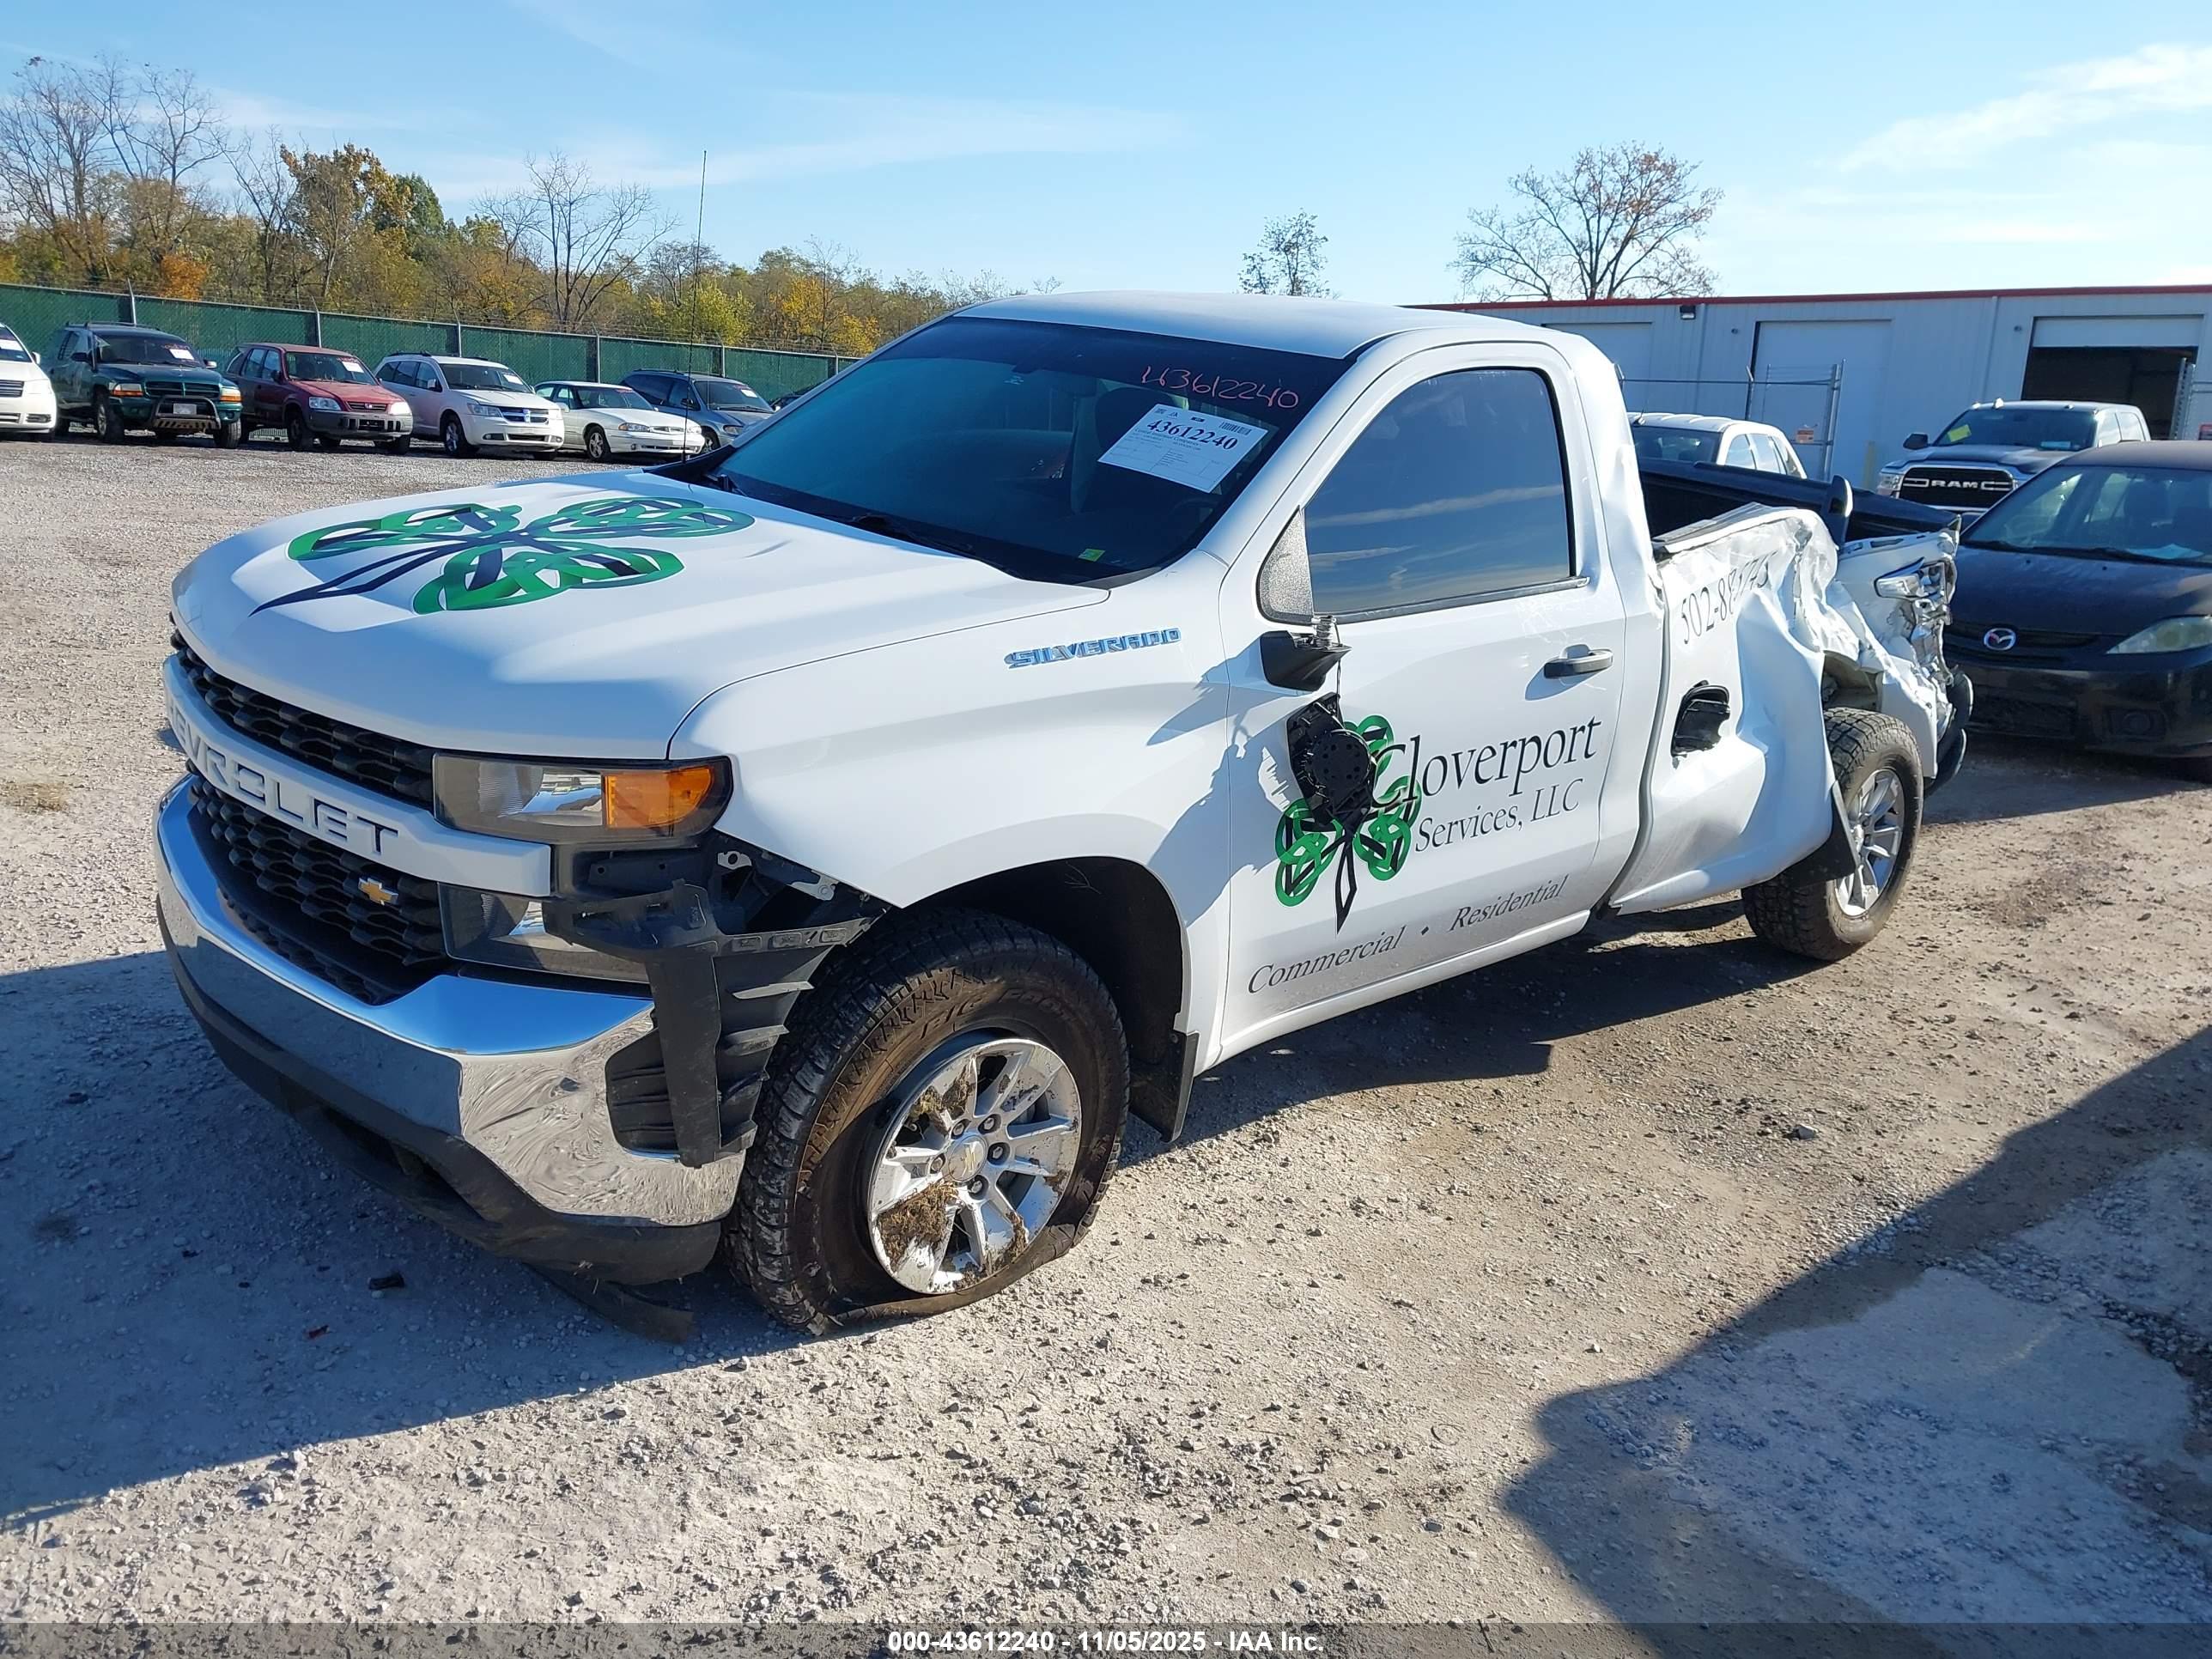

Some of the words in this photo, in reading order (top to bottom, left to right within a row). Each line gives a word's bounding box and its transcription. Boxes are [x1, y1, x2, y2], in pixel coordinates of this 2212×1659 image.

[1141, 366, 1298, 409] 43612240
[1146, 419, 1238, 450] 43612240
[1931, 480, 1978, 489] RAM
[1003, 627, 1182, 669] SILVERADO
[1415, 805, 1523, 853] Services,
[1530, 778, 1583, 823] LLC
[1248, 925, 1407, 994] Commercial
[1449, 874, 1570, 933] Residential
